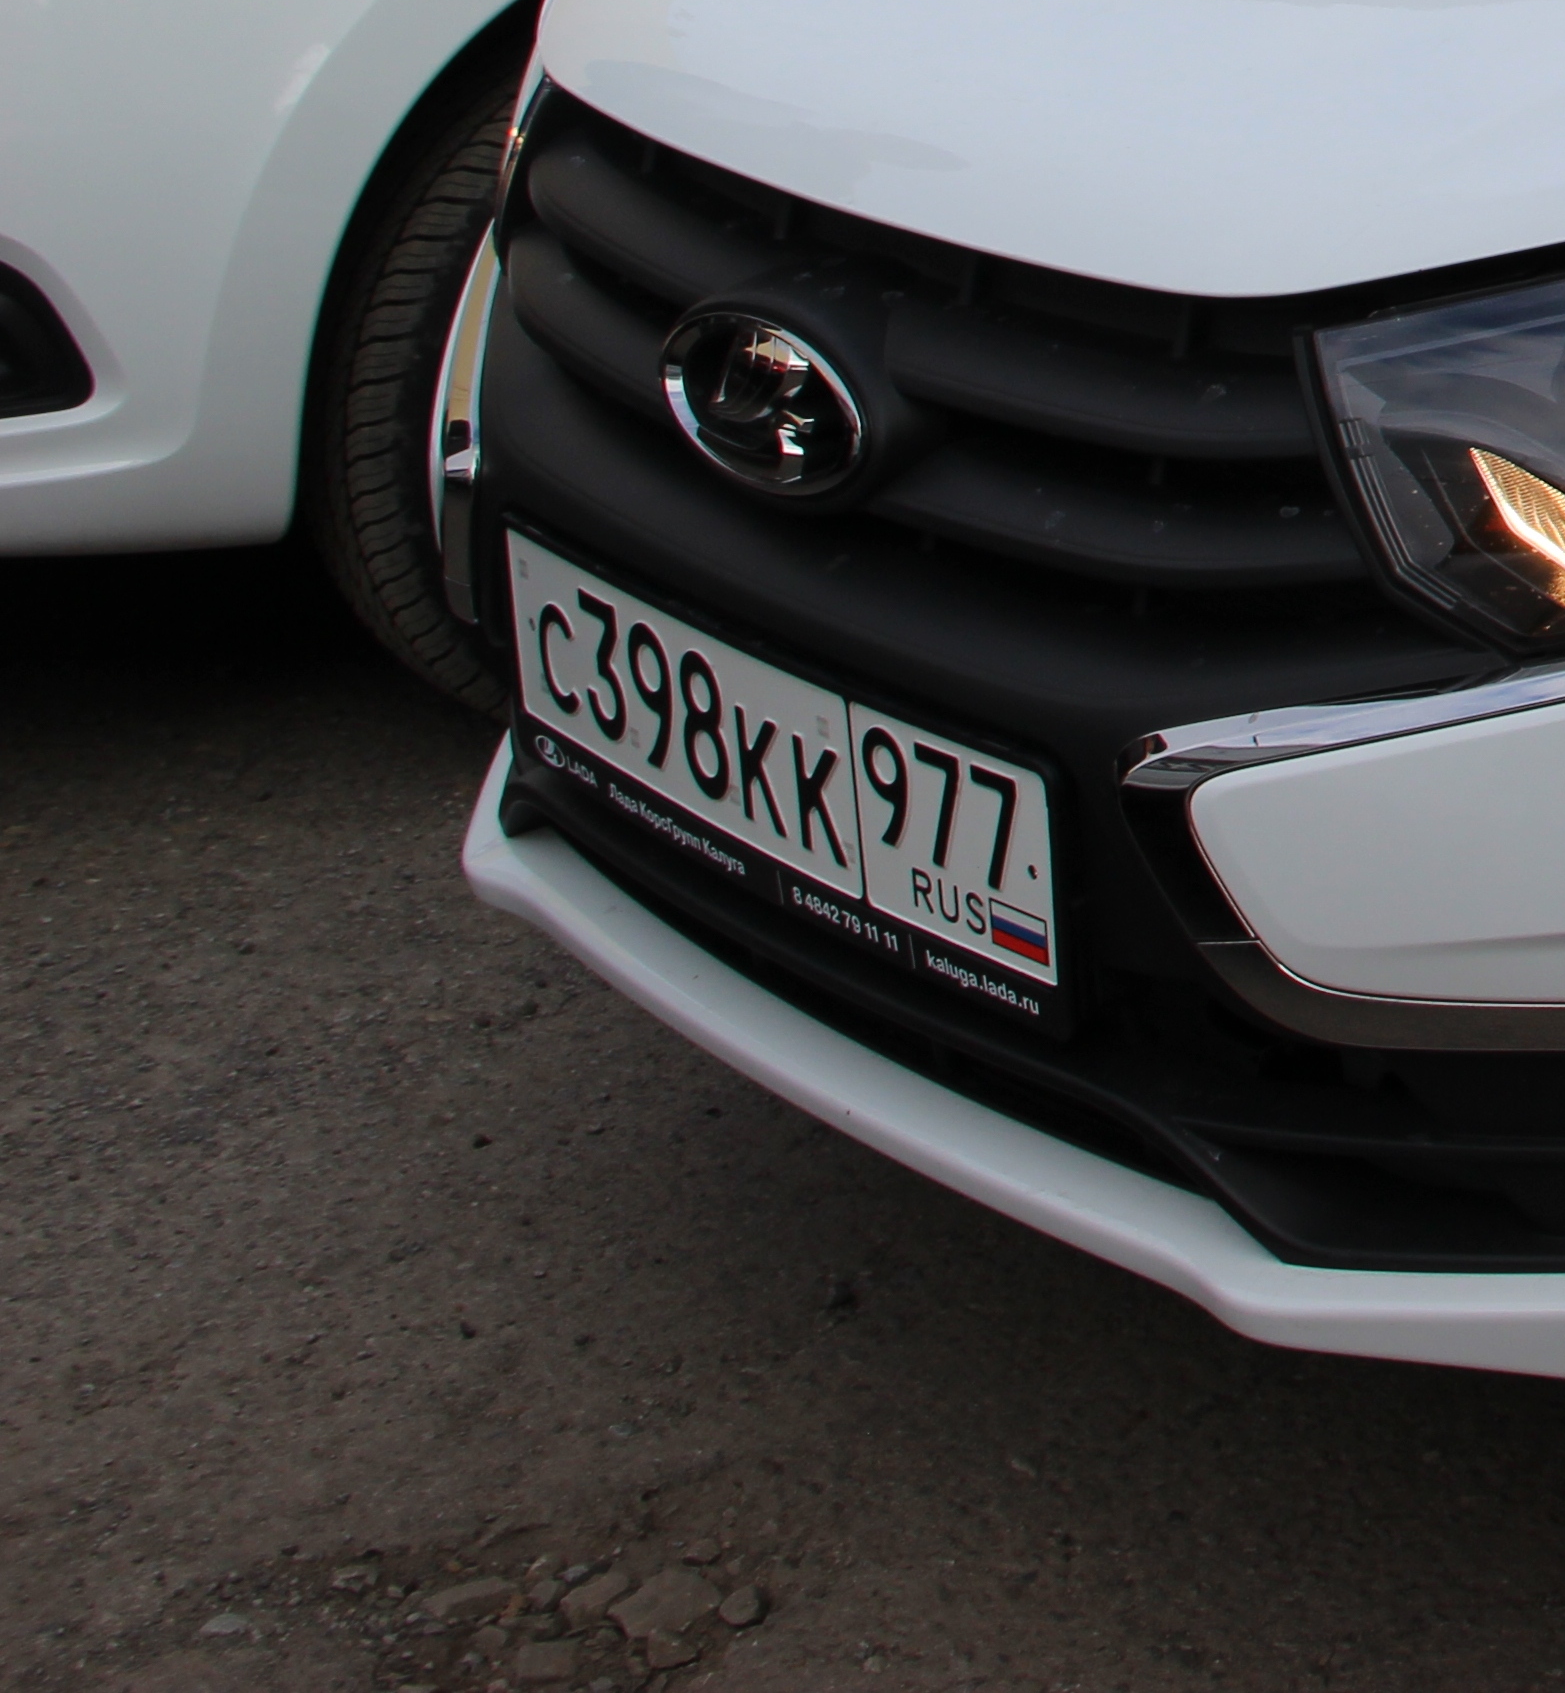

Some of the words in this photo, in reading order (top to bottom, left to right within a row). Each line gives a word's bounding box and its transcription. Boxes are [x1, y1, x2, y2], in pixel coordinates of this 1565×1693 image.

[566, 755, 599, 789] LADA
[609, 782, 639, 814] Лада
[702, 836, 747, 876] Калуга
[861, 725, 1017, 891] 977
[791, 885, 803, 905] 8
[804, 893, 841, 924] 4842
[841, 910, 862, 934] 79
[864, 921, 880, 944] 11
[883, 930, 899, 953] 11
[911, 867, 987, 936] RUS
[925, 948, 1041, 1017] kaluga.lada.ru
